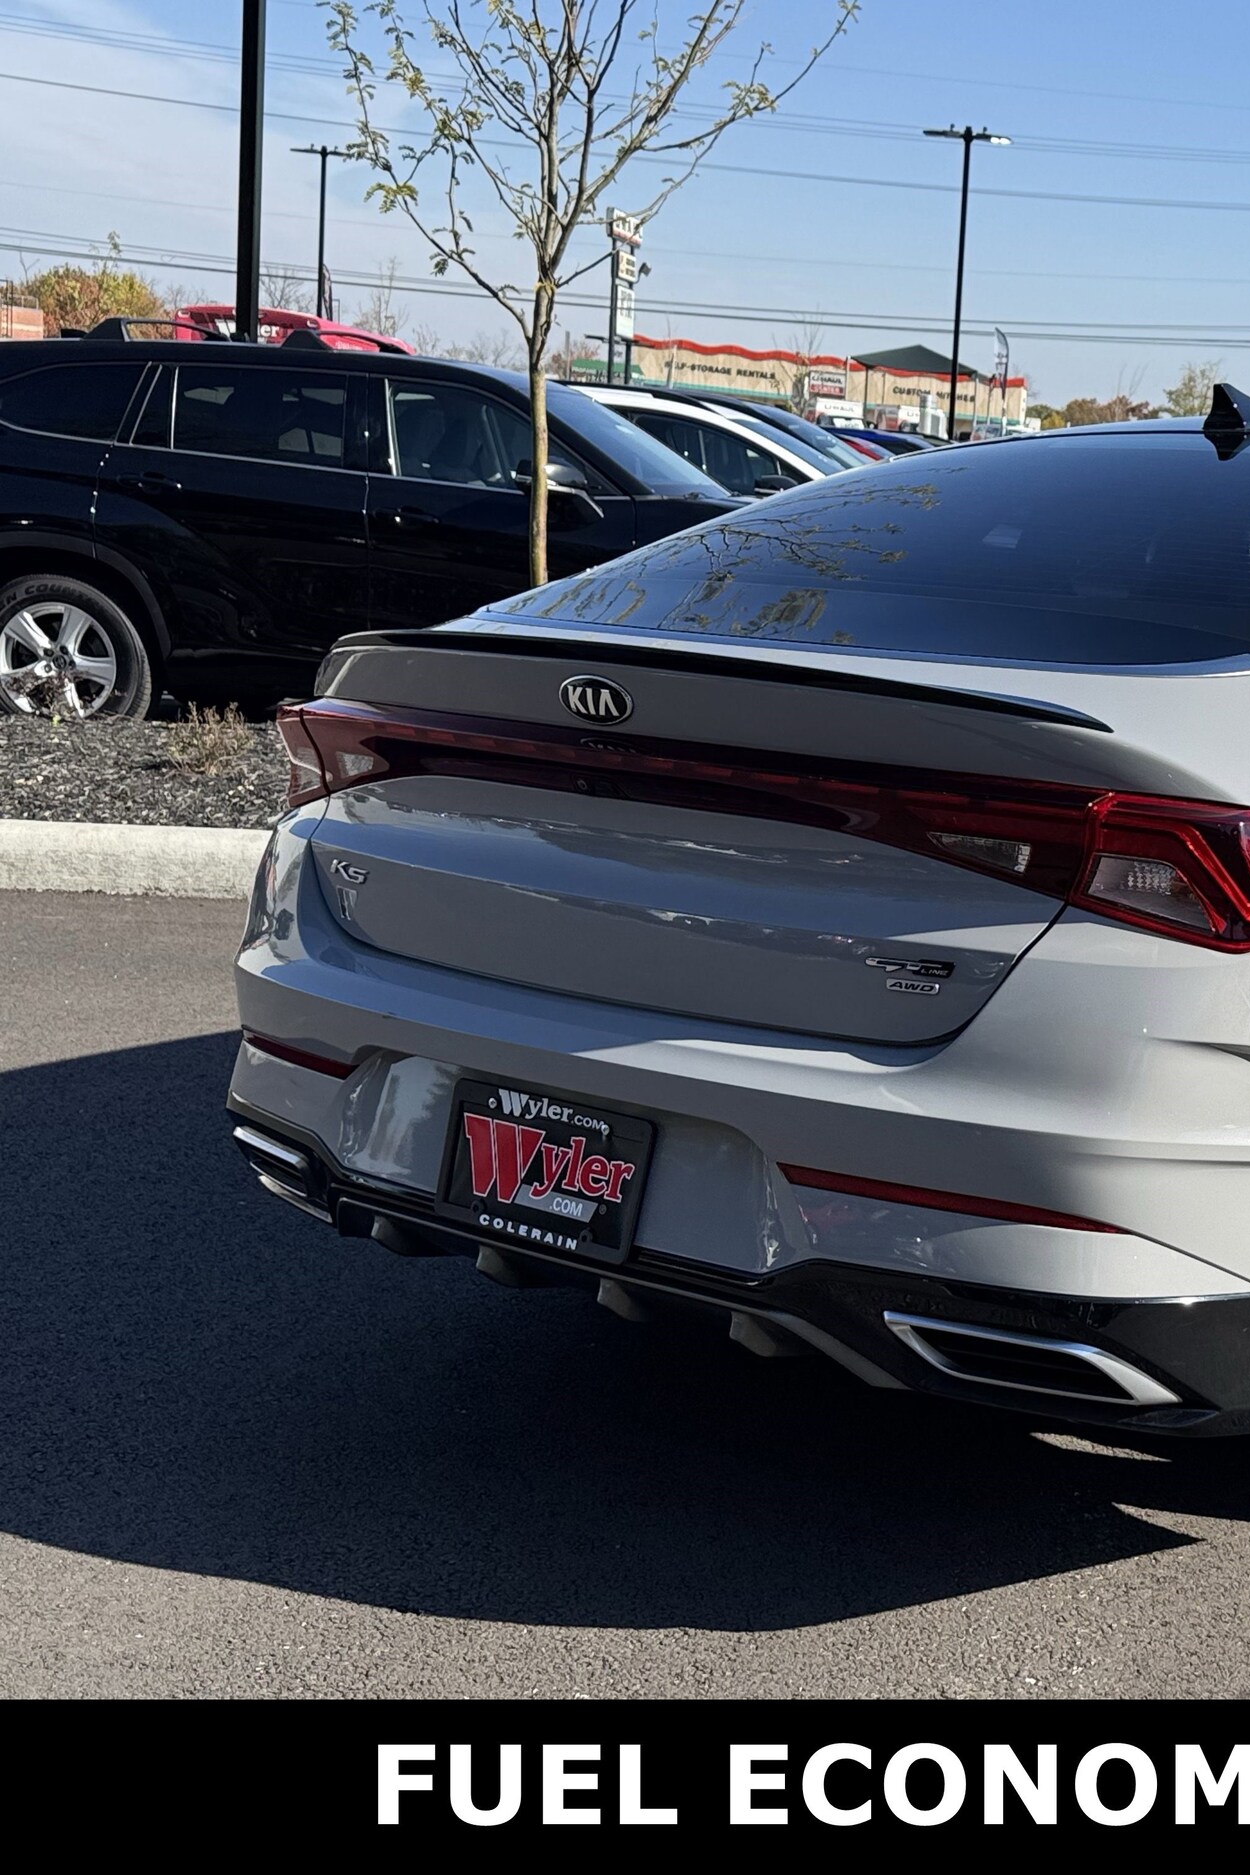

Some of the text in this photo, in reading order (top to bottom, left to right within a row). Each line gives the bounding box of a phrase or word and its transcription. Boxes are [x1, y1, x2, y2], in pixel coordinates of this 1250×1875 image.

[664, 361, 776, 379] SLF-STORAGE RENTALS
[936, 391, 975, 403] HITHES
[567, 685, 620, 717] KIA
[330, 859, 370, 884] K5
[889, 981, 935, 992] AWD
[463, 1112, 635, 1204] Wyler
[549, 1196, 583, 1217] .COM
[478, 1213, 579, 1251] COLERAIN
